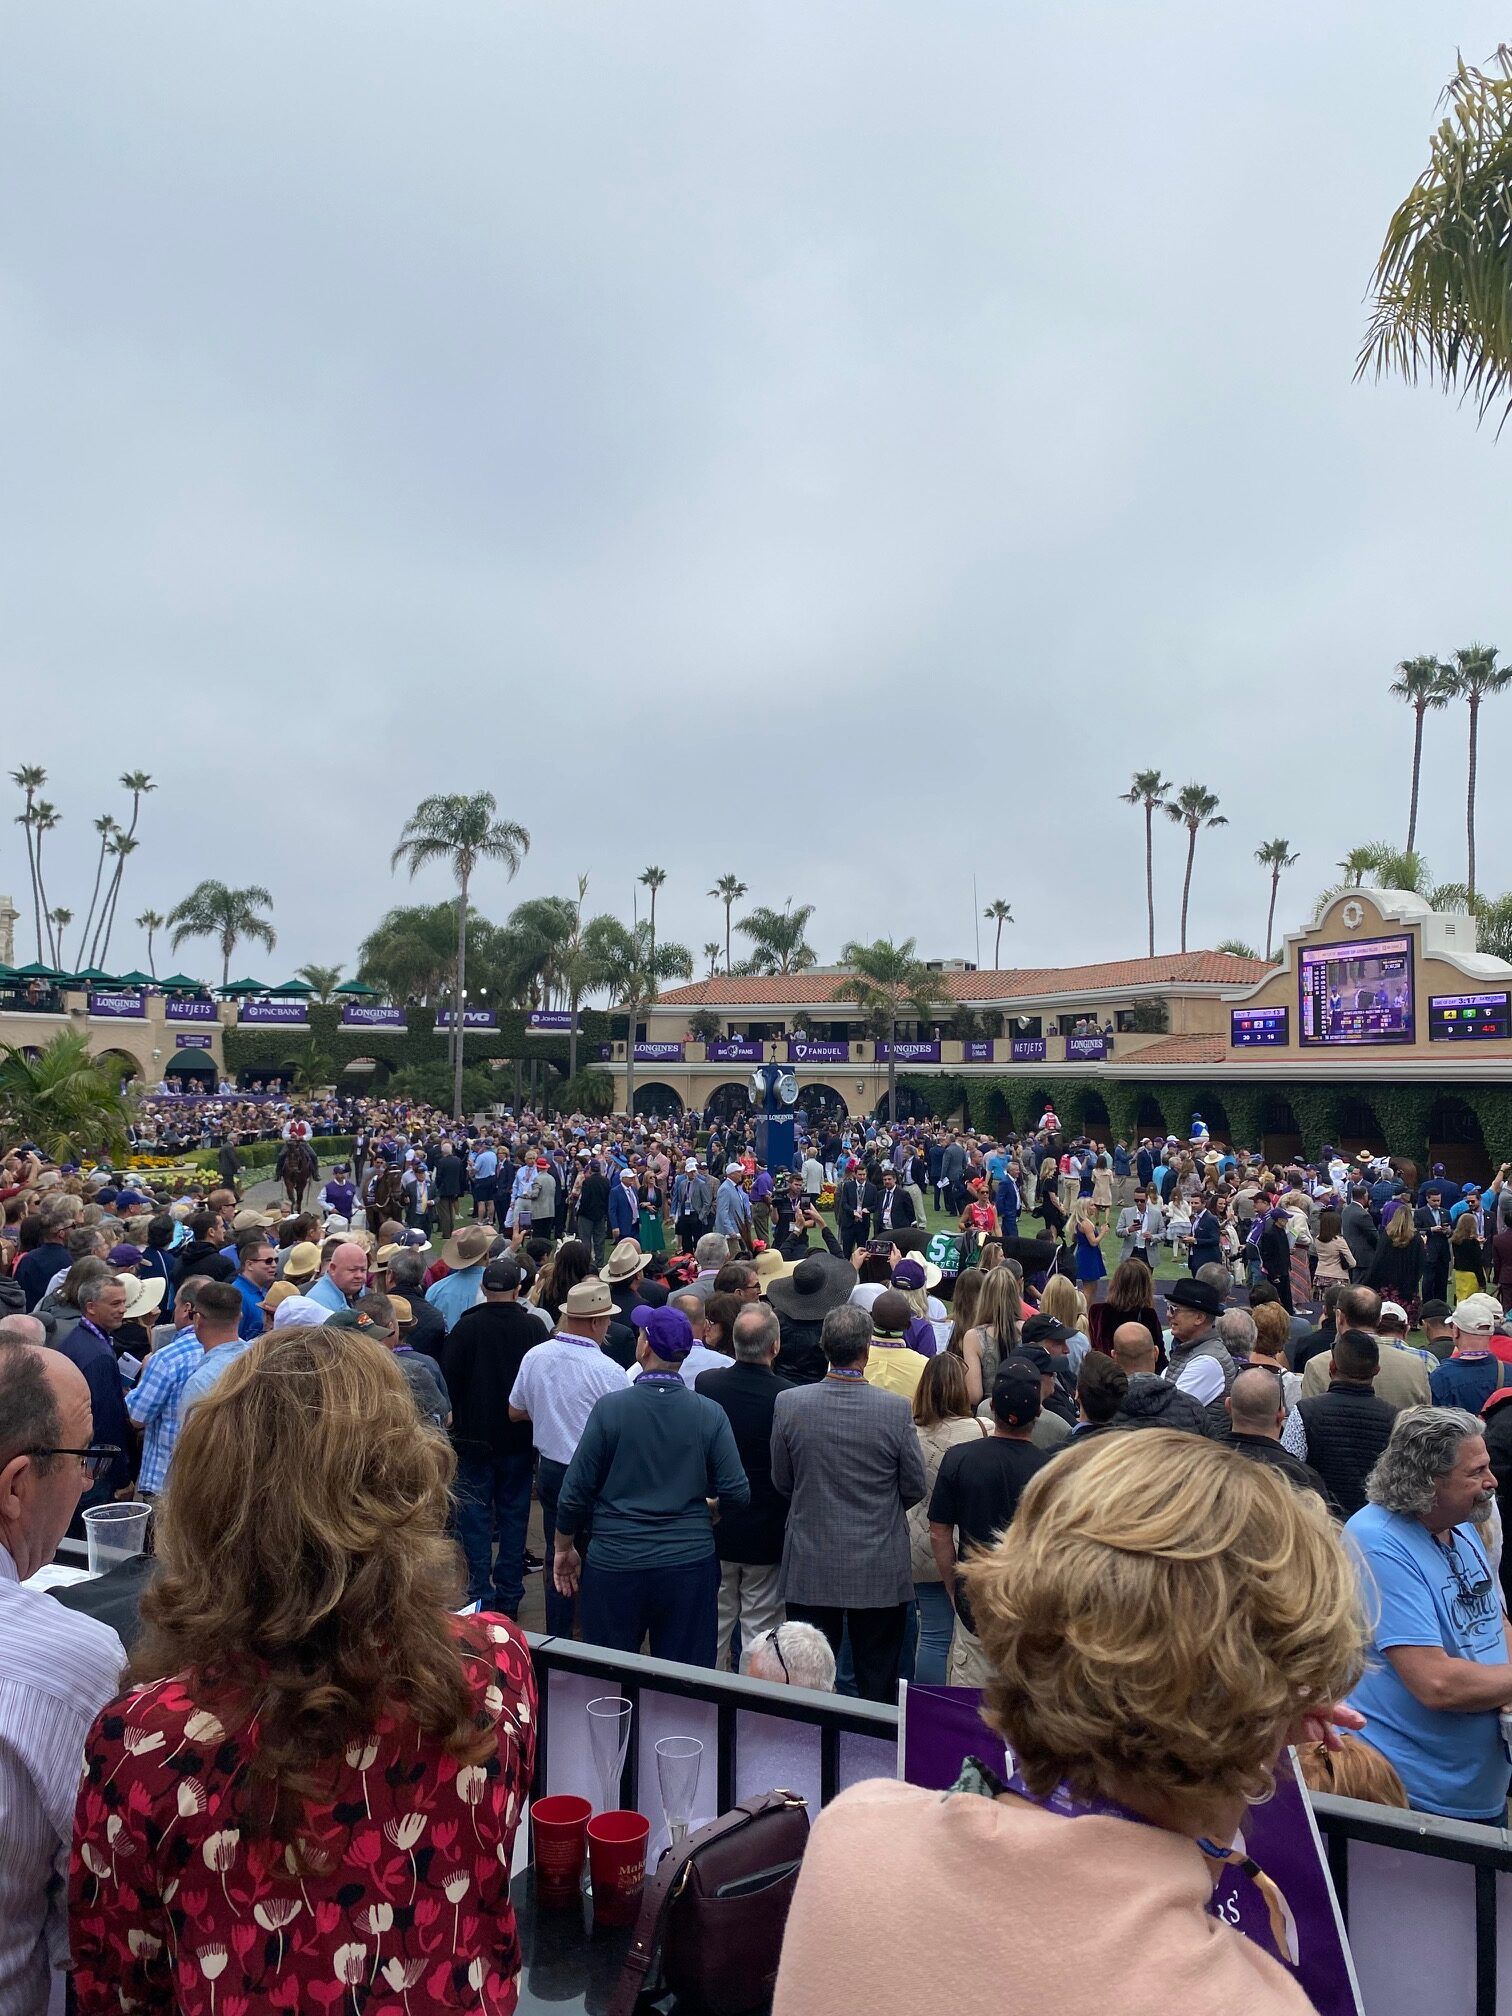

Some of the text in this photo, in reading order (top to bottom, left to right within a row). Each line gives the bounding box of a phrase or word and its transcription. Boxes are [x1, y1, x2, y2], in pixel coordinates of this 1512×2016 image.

[97, 998, 140, 1009] LONGINES
[171, 1003, 212, 1015] NETJETS
[350, 1008, 400, 1018] LONGINES
[634, 1044, 679, 1052] LONGINES
[1014, 1042, 1043, 1055] NETJETS
[1070, 1039, 1103, 1049] LONGINES
[929, 1234, 950, 1261] 5
